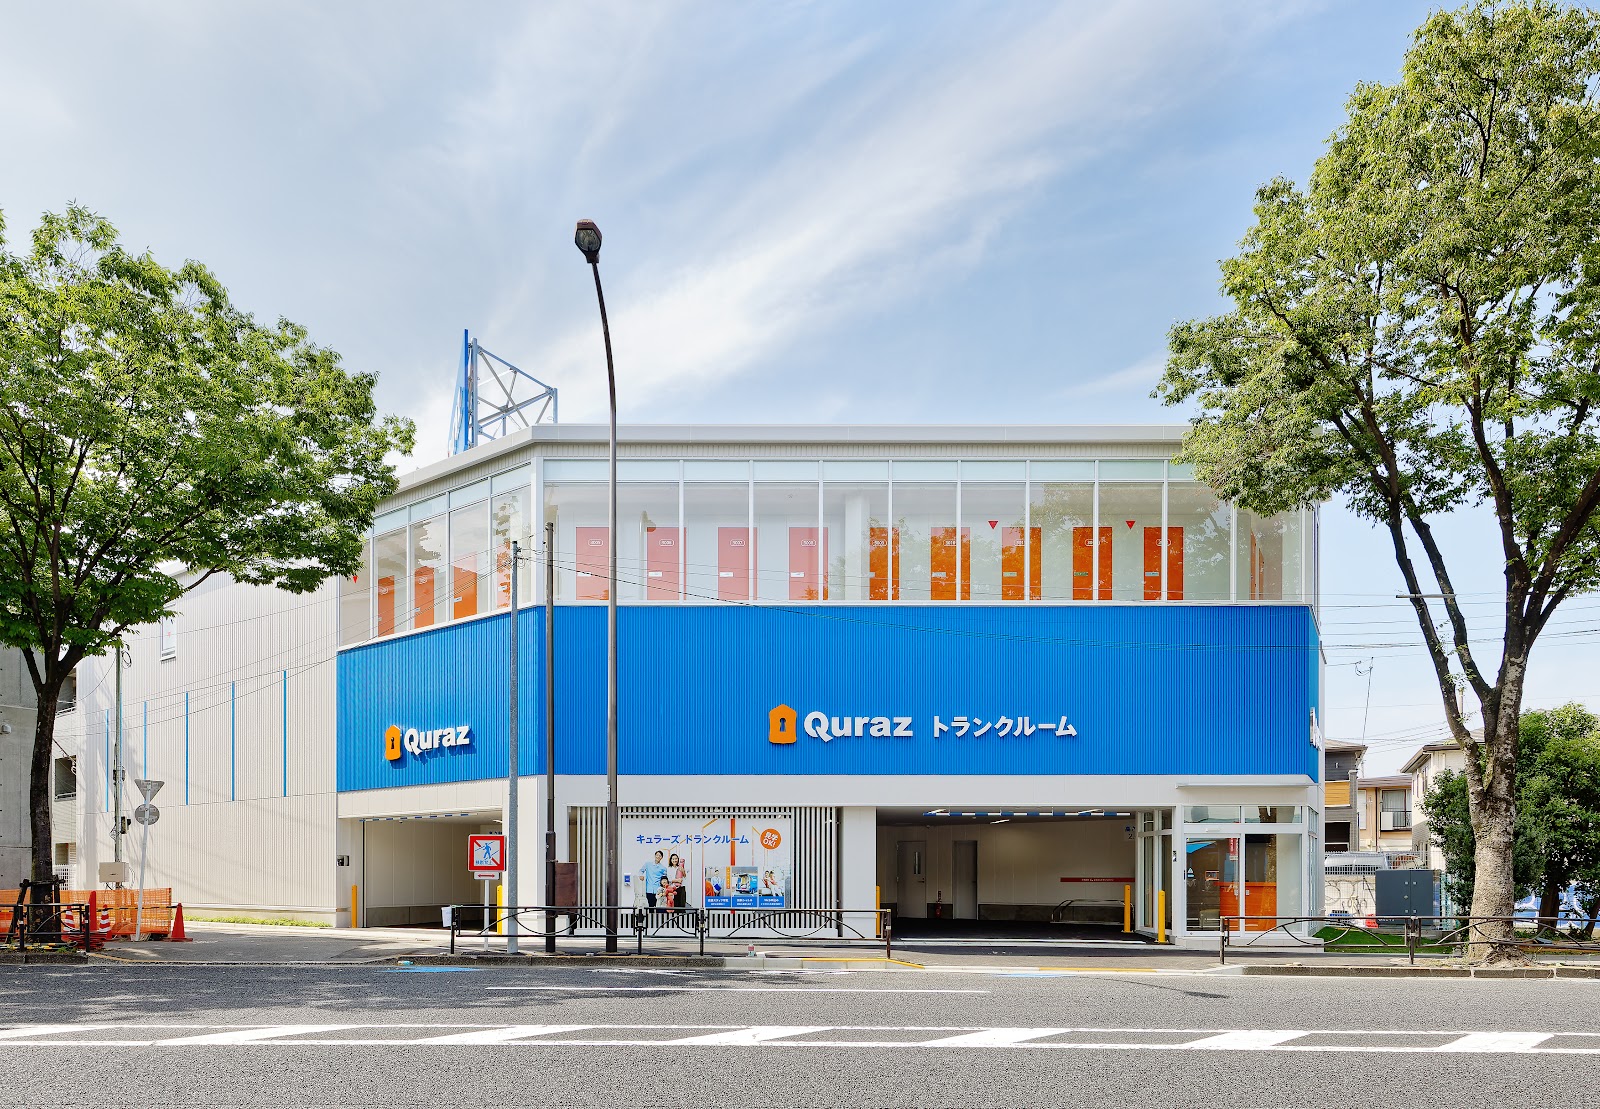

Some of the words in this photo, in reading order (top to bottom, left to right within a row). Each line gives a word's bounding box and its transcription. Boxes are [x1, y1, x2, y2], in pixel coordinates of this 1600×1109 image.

[404, 725, 470, 756] Quraz
[804, 711, 914, 743] Quraz
[933, 715, 1078, 738] トランクルーム
[636, 834, 681, 844] キュラーズ
[685, 834, 750, 844] トランクルーム
